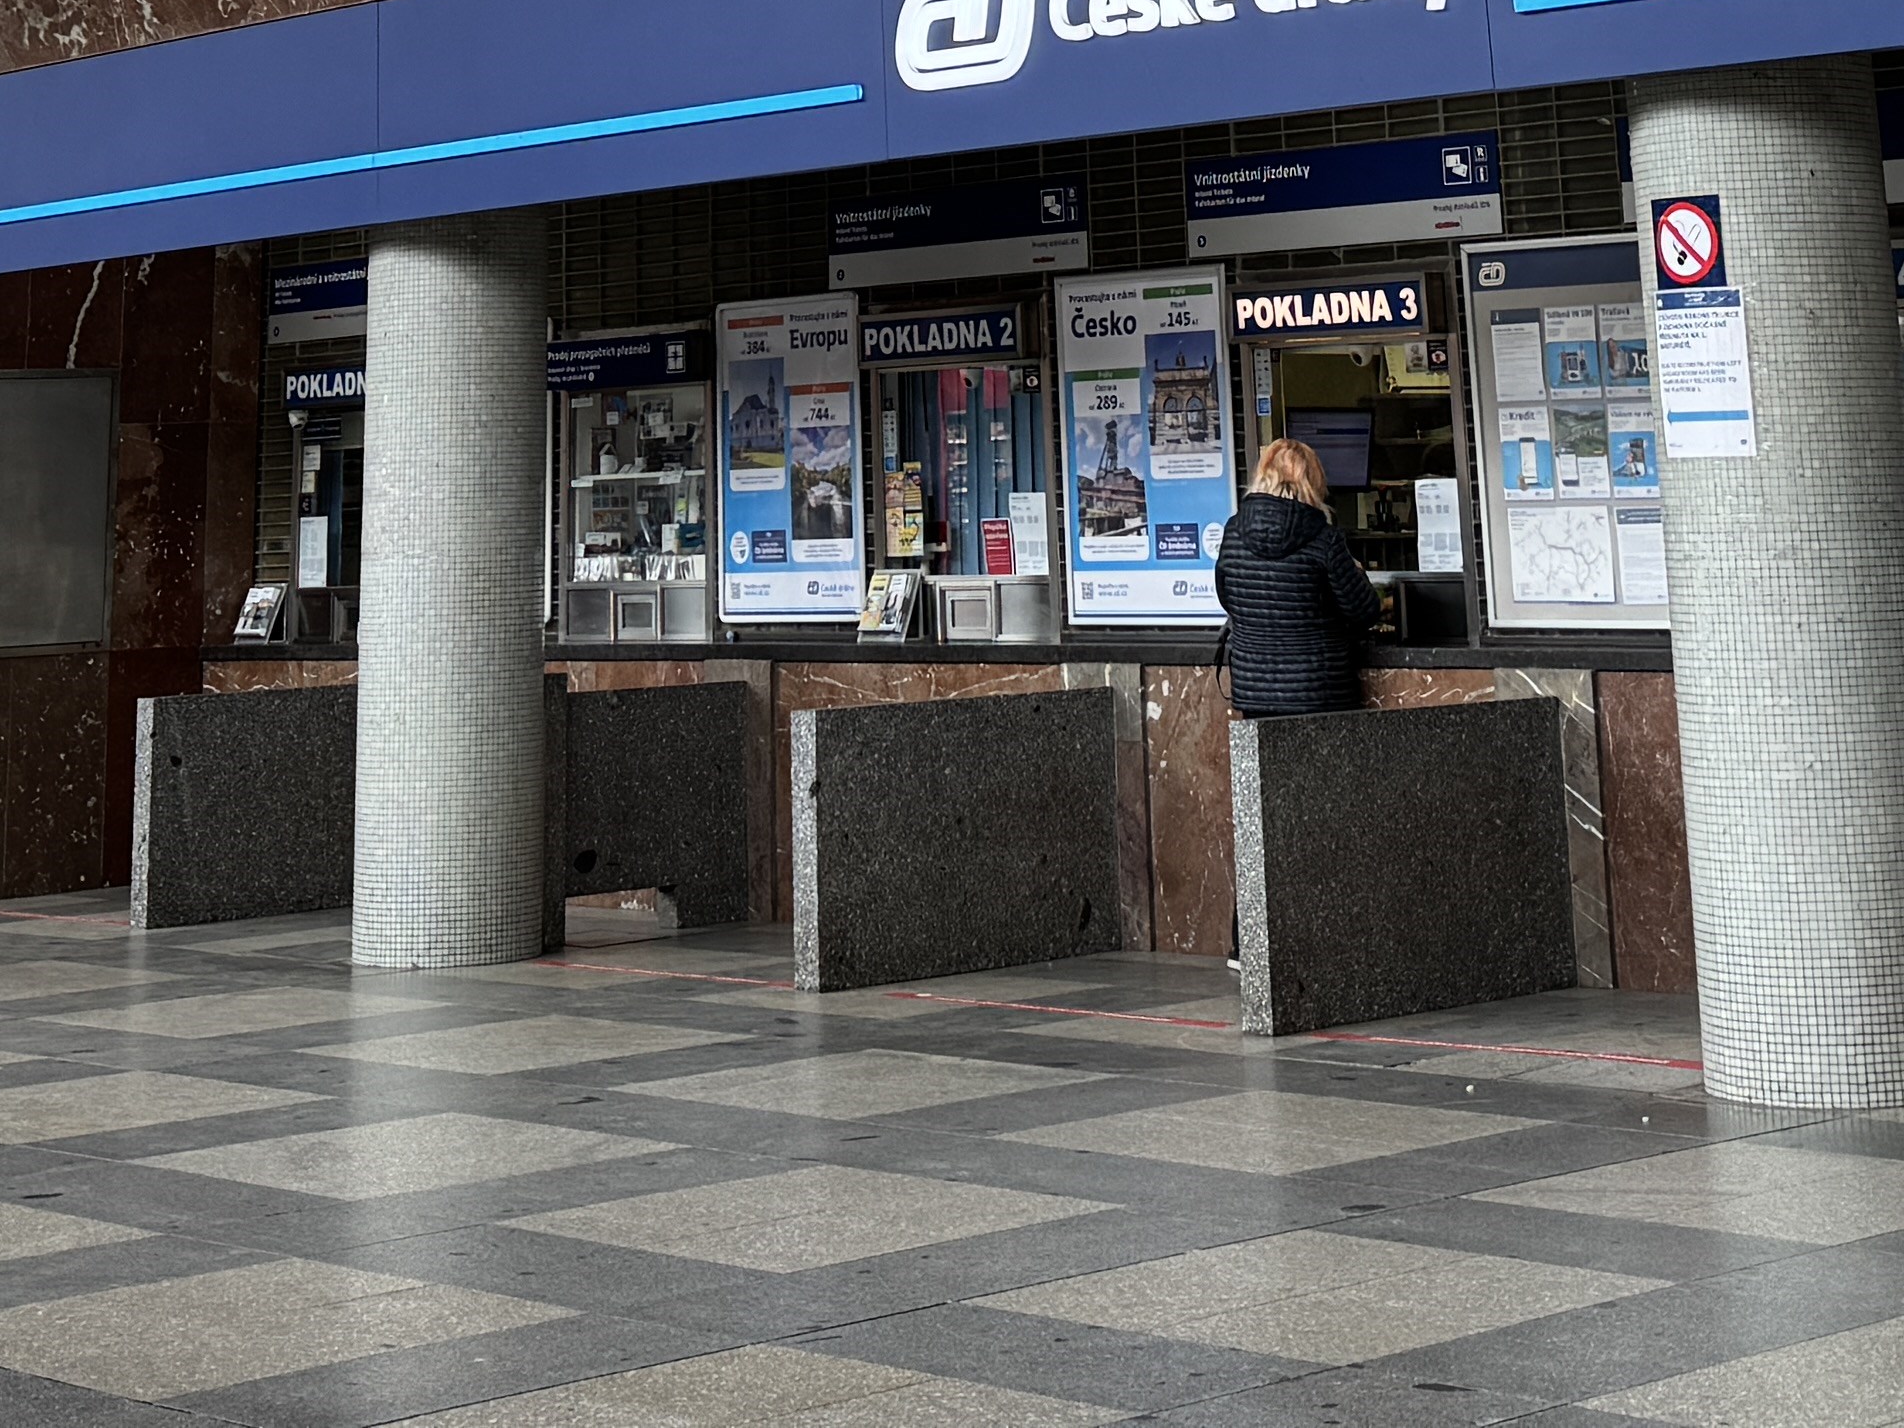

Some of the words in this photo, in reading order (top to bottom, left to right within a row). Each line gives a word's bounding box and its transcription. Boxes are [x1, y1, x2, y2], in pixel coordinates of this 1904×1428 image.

[1194, 169, 1262, 188] Vnitrostátní
[1263, 162, 1310, 183] jízdenky
[1167, 311, 1191, 327] 145
[1236, 289, 1393, 330] POKLADNA
[1399, 287, 1418, 320] 3
[1071, 307, 1137, 338] Česko
[746, 340, 765, 355] 384
[789, 328, 849, 352] Evropu
[864, 319, 994, 356] POKLADNA
[999, 317, 1015, 347] 2
[809, 407, 830, 422] 744
[1096, 395, 1118, 410] 289
